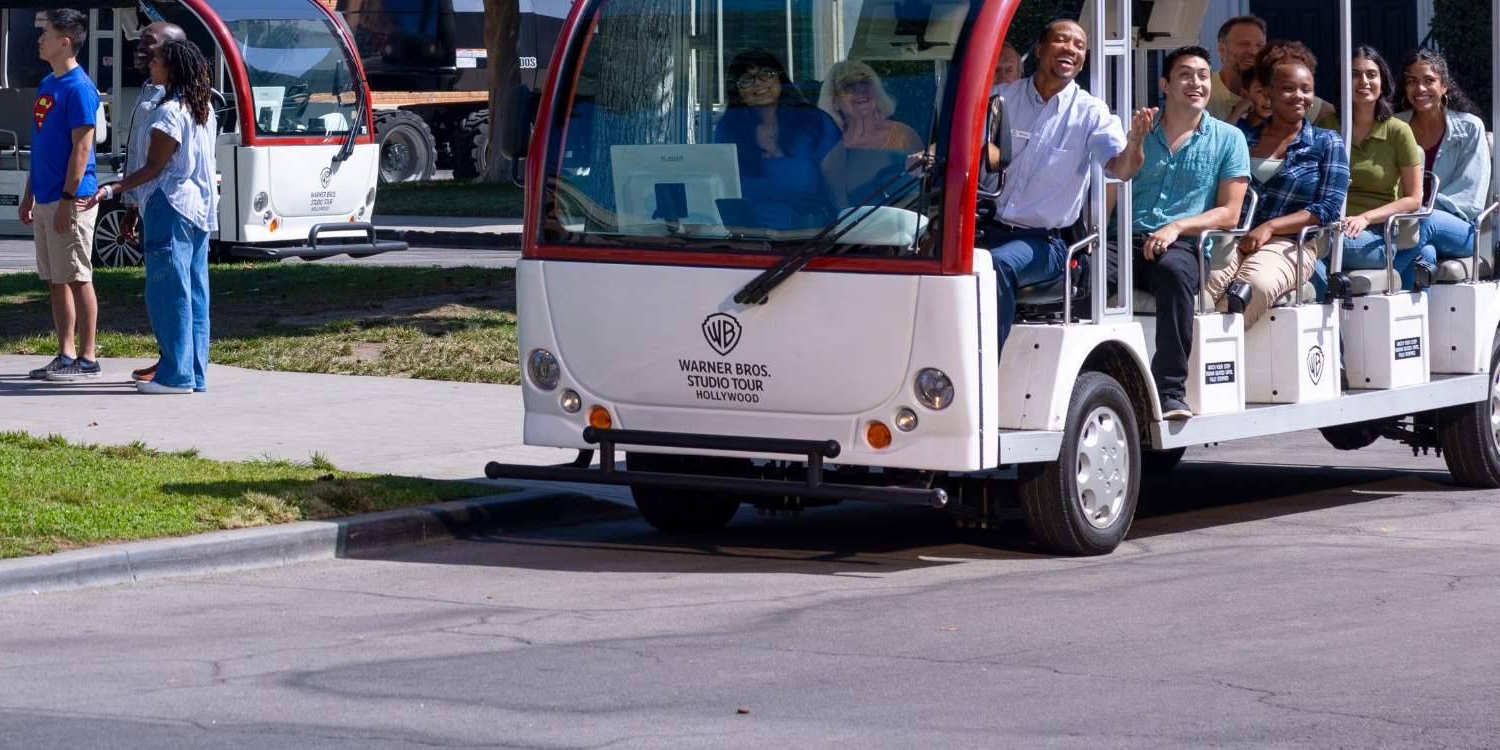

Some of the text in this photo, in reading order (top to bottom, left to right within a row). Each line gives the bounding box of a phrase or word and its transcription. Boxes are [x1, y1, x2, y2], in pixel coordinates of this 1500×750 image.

[679, 359, 771, 377] WARNER BROS.
[687, 375, 764, 391] STUDIO TOUR
[696, 390, 759, 403] HOLLYWOOD
